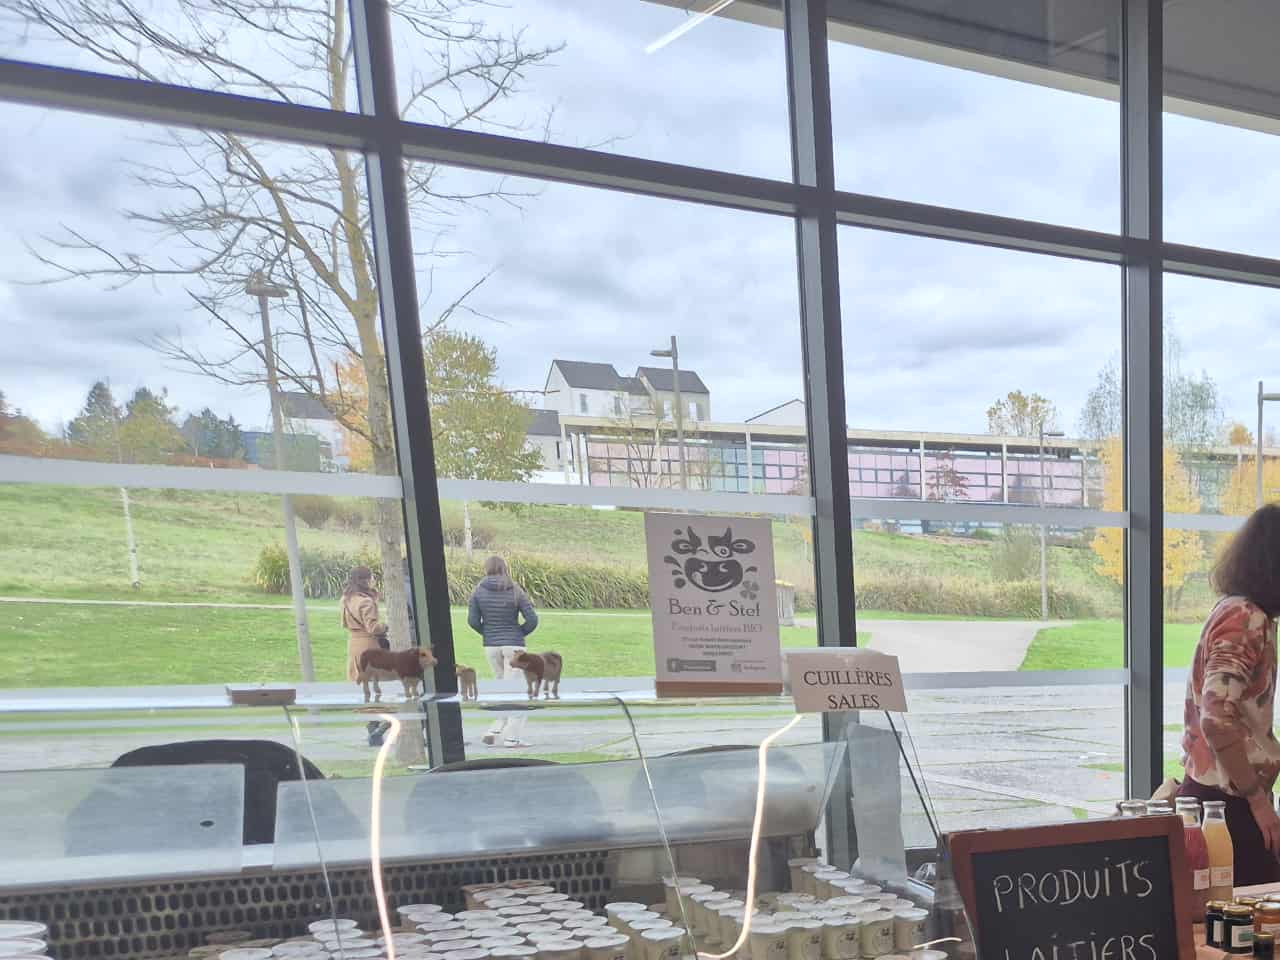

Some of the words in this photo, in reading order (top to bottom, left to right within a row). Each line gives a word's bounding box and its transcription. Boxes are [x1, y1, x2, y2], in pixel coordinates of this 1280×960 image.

[668, 598, 702, 615] Ben
[705, 599, 726, 616] &
[827, 694, 880, 710] SALES
